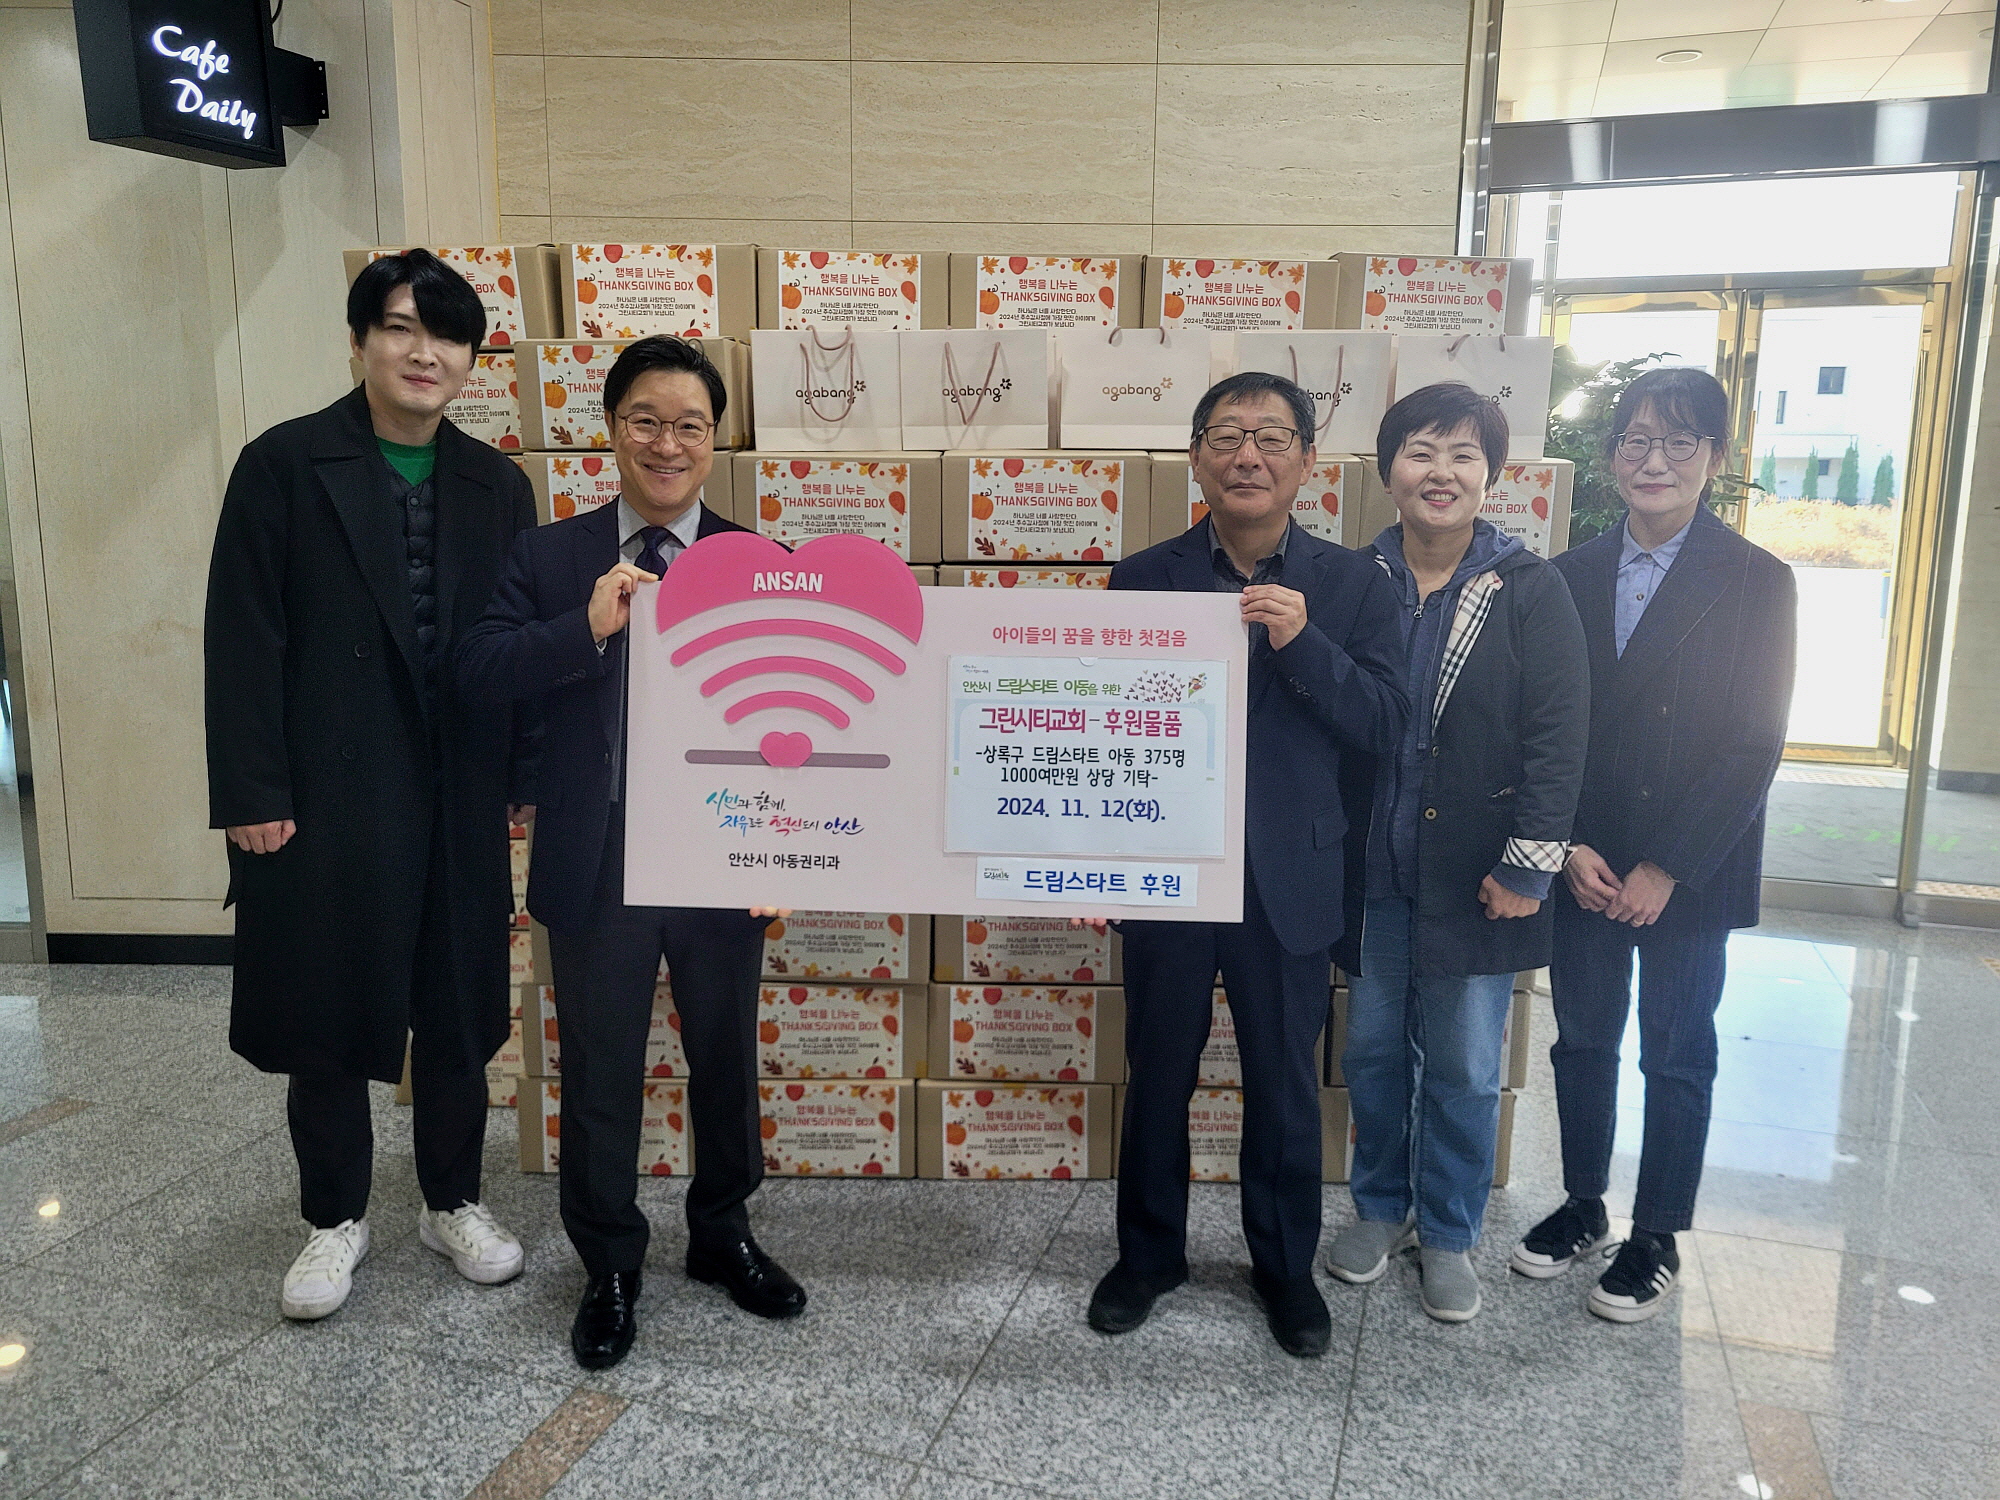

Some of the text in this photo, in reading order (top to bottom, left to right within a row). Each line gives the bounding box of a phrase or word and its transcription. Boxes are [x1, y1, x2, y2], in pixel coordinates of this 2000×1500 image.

[152, 25, 229, 81] Cafe
[169, 78, 256, 139] Daily
[615, 267, 675, 278] 행복을 나누는
[820, 273, 879, 285] 행복을 나누는
[1018, 279, 1078, 290] 행복을 나누는
[475, 283, 496, 293] BOX
[598, 281, 694, 291] THANKSGIVING BOX
[802, 286, 898, 297] THANKSGIVING BOX
[1204, 282, 1264, 294] 행복을 나누는
[1407, 280, 1466, 293] 행복을 나누는
[1000, 292, 1096, 303] THANKSGIVING BOX
[1185, 295, 1282, 307] THANKSGIVING BOX
[1387, 293, 1484, 305] THANKSGIVING BOX
[586, 368, 612, 380] 행복
[487, 389, 507, 399] BOX
[795, 387, 856, 405] agabang
[942, 385, 1002, 403] agabang
[1102, 383, 1163, 402] agabang
[1306, 389, 1342, 407] bang
[802, 483, 866, 495] 행복을 나누는
[1014, 482, 1078, 494] 행복을 나누는
[782, 497, 885, 508] THANKSGIVING BOX
[994, 496, 1098, 507] THANKSGIVING BOX
[1296, 500, 1318, 511] BOX
[1506, 504, 1528, 514] BOX
[752, 571, 823, 593] ANSAN
[992, 626, 1187, 647] 아이들의 꿈을 향한 첫걸음
[962, 678, 1121, 696] 안산시 드림스타트 아동을 위한
[975, 745, 1185, 767] -상록구 드림스타트 아동 375명
[1000, 768, 1158, 788] 1000여만원 상당 기탁-
[705, 788, 752, 815] 시민과
[997, 797, 1166, 822] 2024. 11. 12(화).
[718, 814, 865, 838] 자유로운 혁신도시 안산
[728, 852, 840, 870] 안산시 아동권리과
[1023, 870, 1127, 893] 드림스타트
[1140, 873, 1181, 897] 후원
